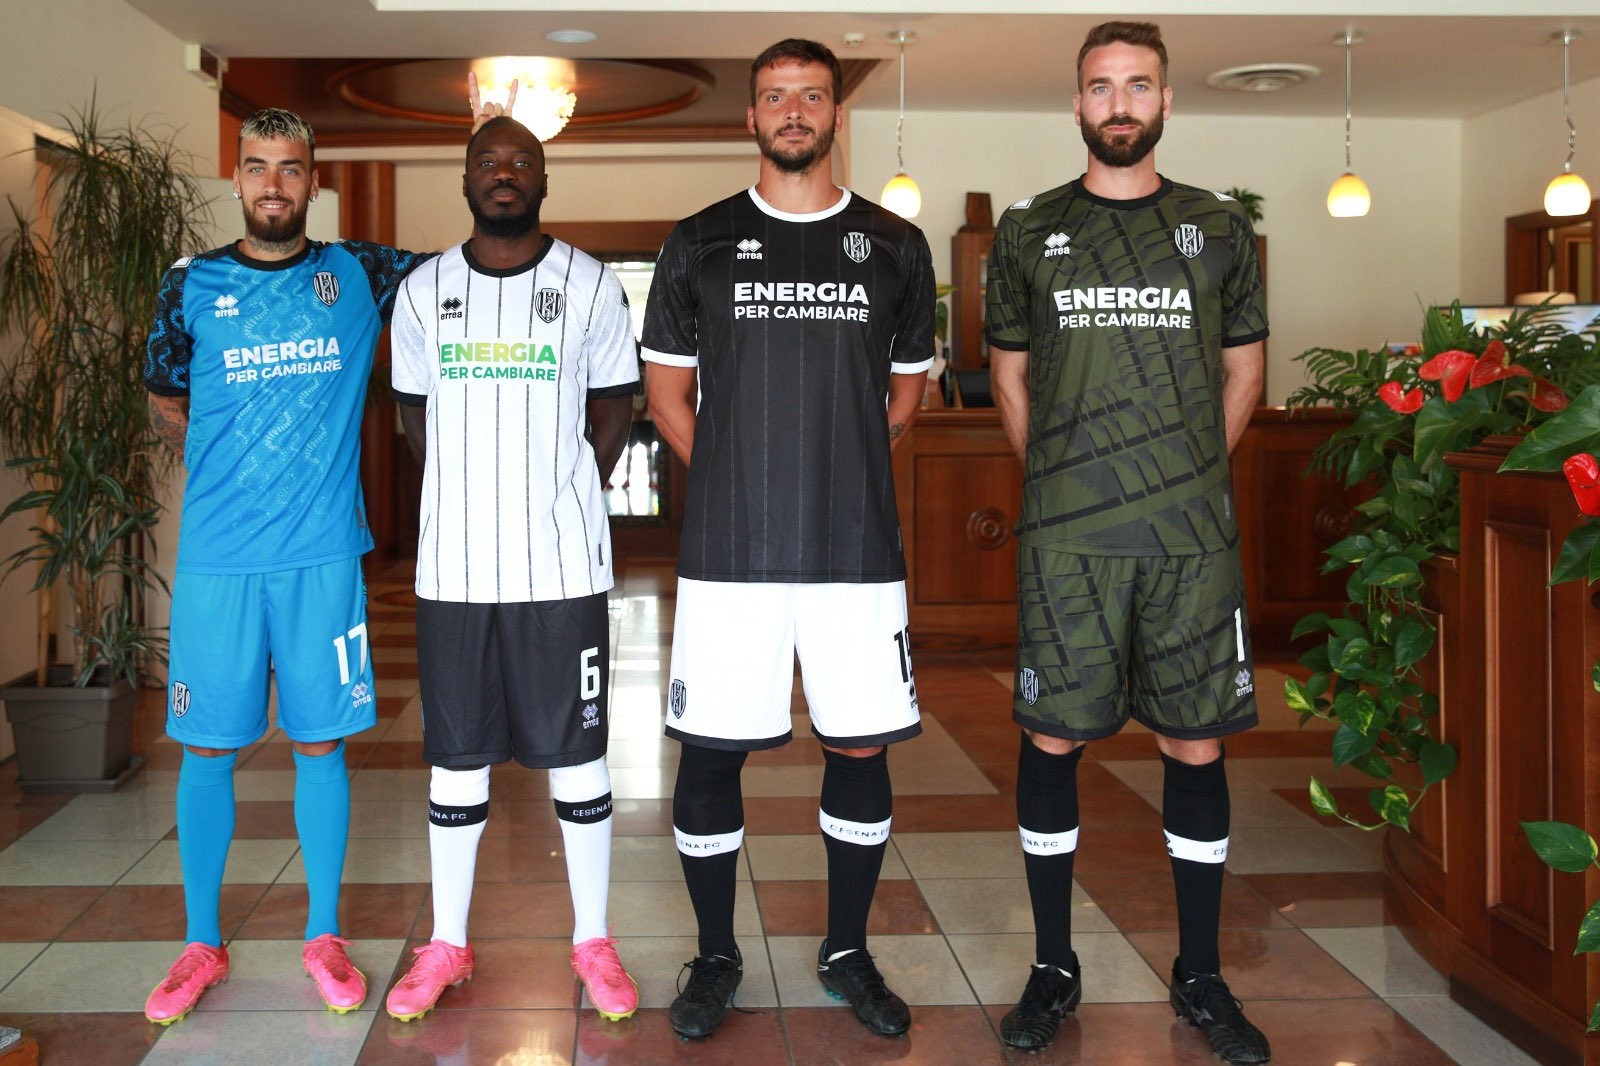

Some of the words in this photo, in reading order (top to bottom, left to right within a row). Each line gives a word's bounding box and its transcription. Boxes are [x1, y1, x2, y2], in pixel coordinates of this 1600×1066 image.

[736, 252, 763, 260] errea
[1044, 246, 1070, 257] errea
[734, 282, 870, 306] ENERGIA
[1053, 287, 1193, 312] ENERGIA
[215, 308, 239, 318] errea
[440, 311, 463, 320] errea
[734, 305, 770, 320] PER
[773, 305, 870, 323] CAMBIARE
[1059, 313, 1091, 330] PER
[1094, 313, 1192, 329] CAMBIARE
[223, 337, 341, 369] ENERGIA
[441, 342, 557, 365] ENERGIA
[226, 369, 258, 385] PER
[261, 359, 342, 379] CAMBIARE
[440, 367, 469, 380] PER
[472, 366, 557, 381] CAMBIARE
[1234, 607, 1246, 663] 1
[333, 621, 368, 686] 17
[580, 646, 600, 701] 6
[451, 813, 467, 821] FC
[572, 803, 608, 817] CESENA
[1043, 841, 1058, 849] FC
